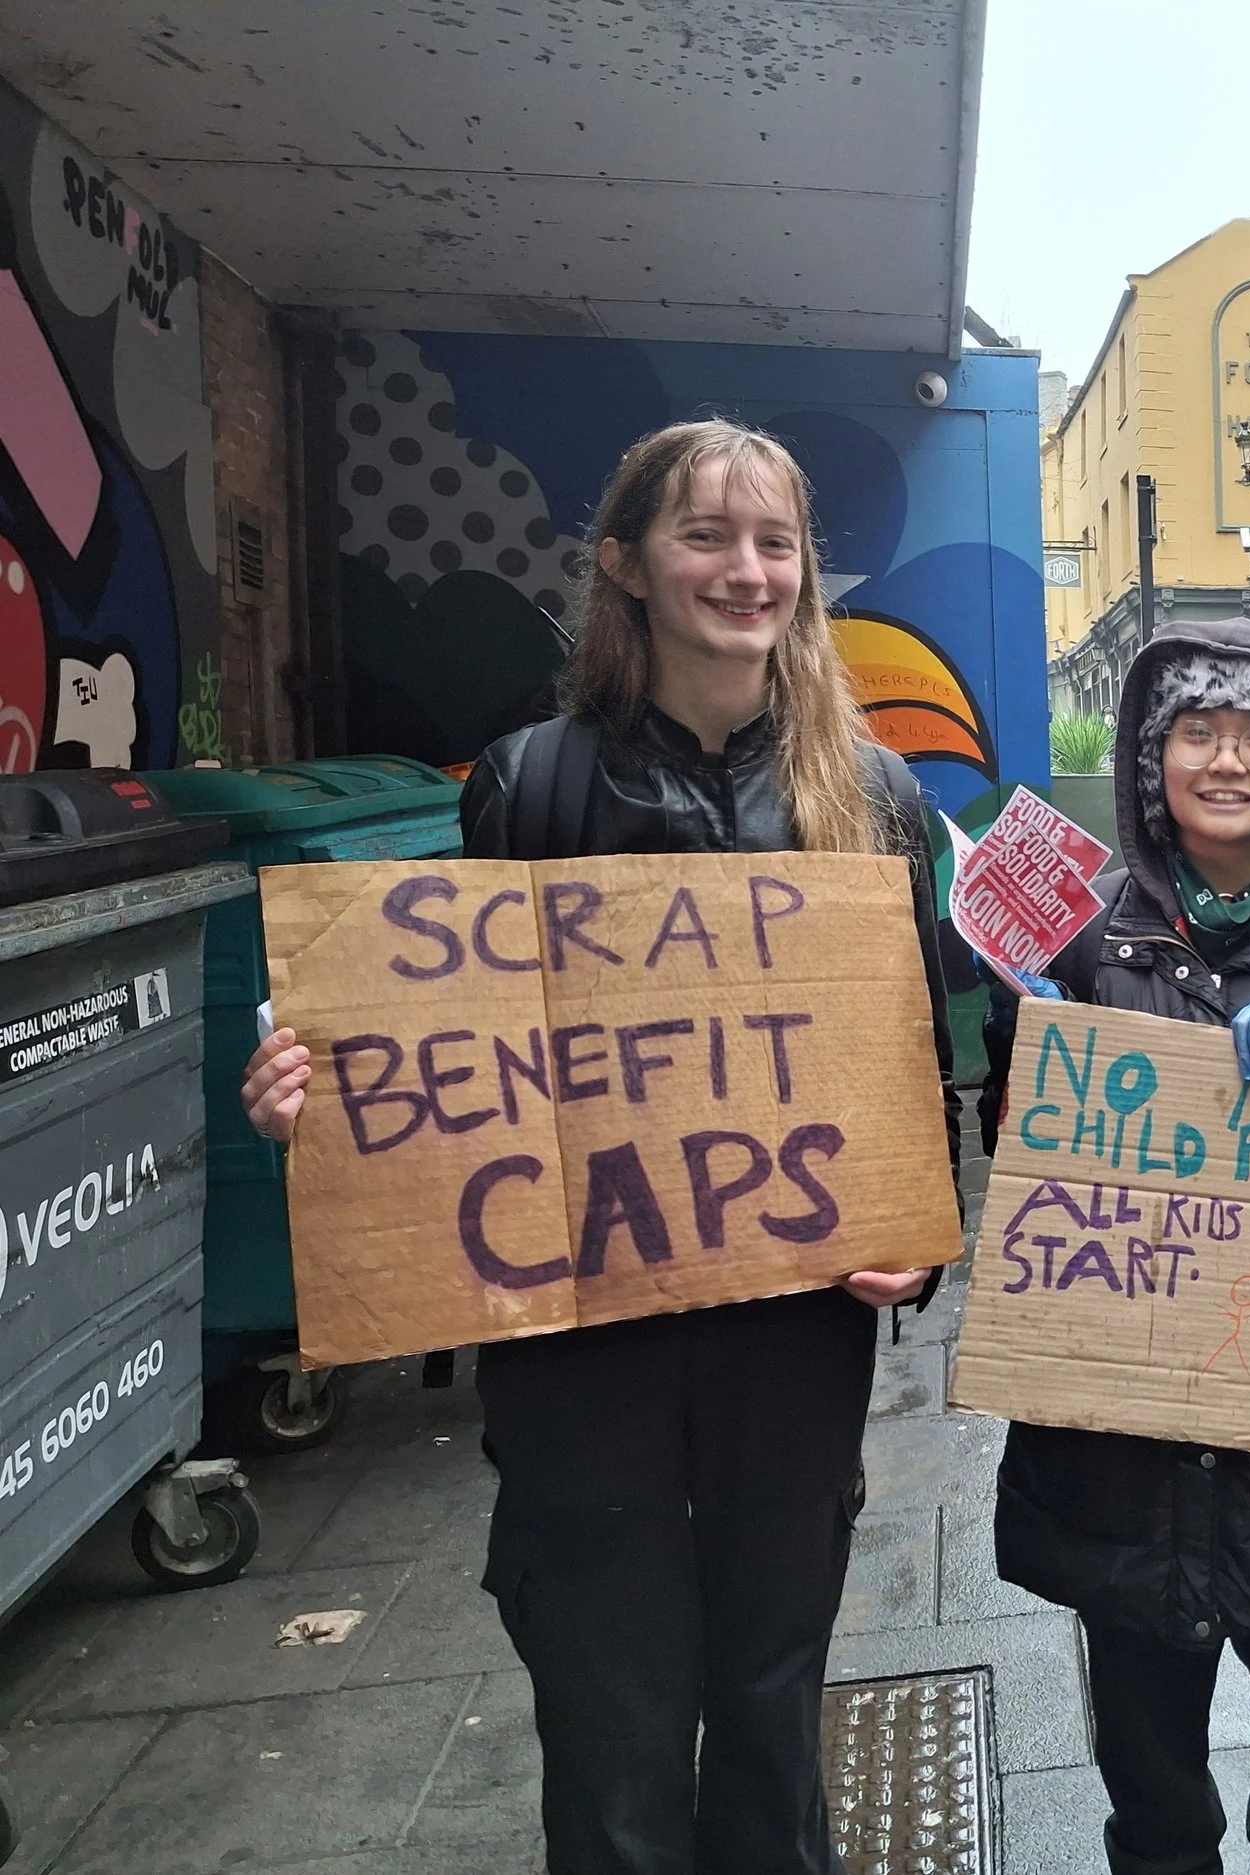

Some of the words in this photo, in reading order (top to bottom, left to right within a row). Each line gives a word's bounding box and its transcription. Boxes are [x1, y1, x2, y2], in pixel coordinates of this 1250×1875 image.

[1047, 561, 1076, 580] FORTH
[1008, 792, 1054, 832] FOOD
[1050, 823, 1067, 843] &
[1016, 829, 1057, 871] FOOD
[1049, 865, 1068, 885] &
[998, 844, 1076, 928] SOLIDARITY
[381, 874, 804, 980] SCRAP
[961, 883, 1013, 939] JOIN
[999, 921, 1051, 976] NOW
[42, 985, 129, 1033] NON-HAZARDOUS
[10, 1027, 87, 1073] COMPACTABLE
[331, 1013, 813, 1156] BENEFIT
[1034, 1022, 1159, 1114] NO
[1020, 1104, 1206, 1178] CHILD
[16, 1143, 161, 1267] VEOLIA
[457, 1122, 847, 1290] CAPS
[1004, 1178, 1142, 1237] ALL
[1163, 1192, 1244, 1242] KIDS
[1001, 1231, 1200, 1299] START.
[41, 1380, 109, 1465] 6060
[117, 1339, 164, 1400] 460
